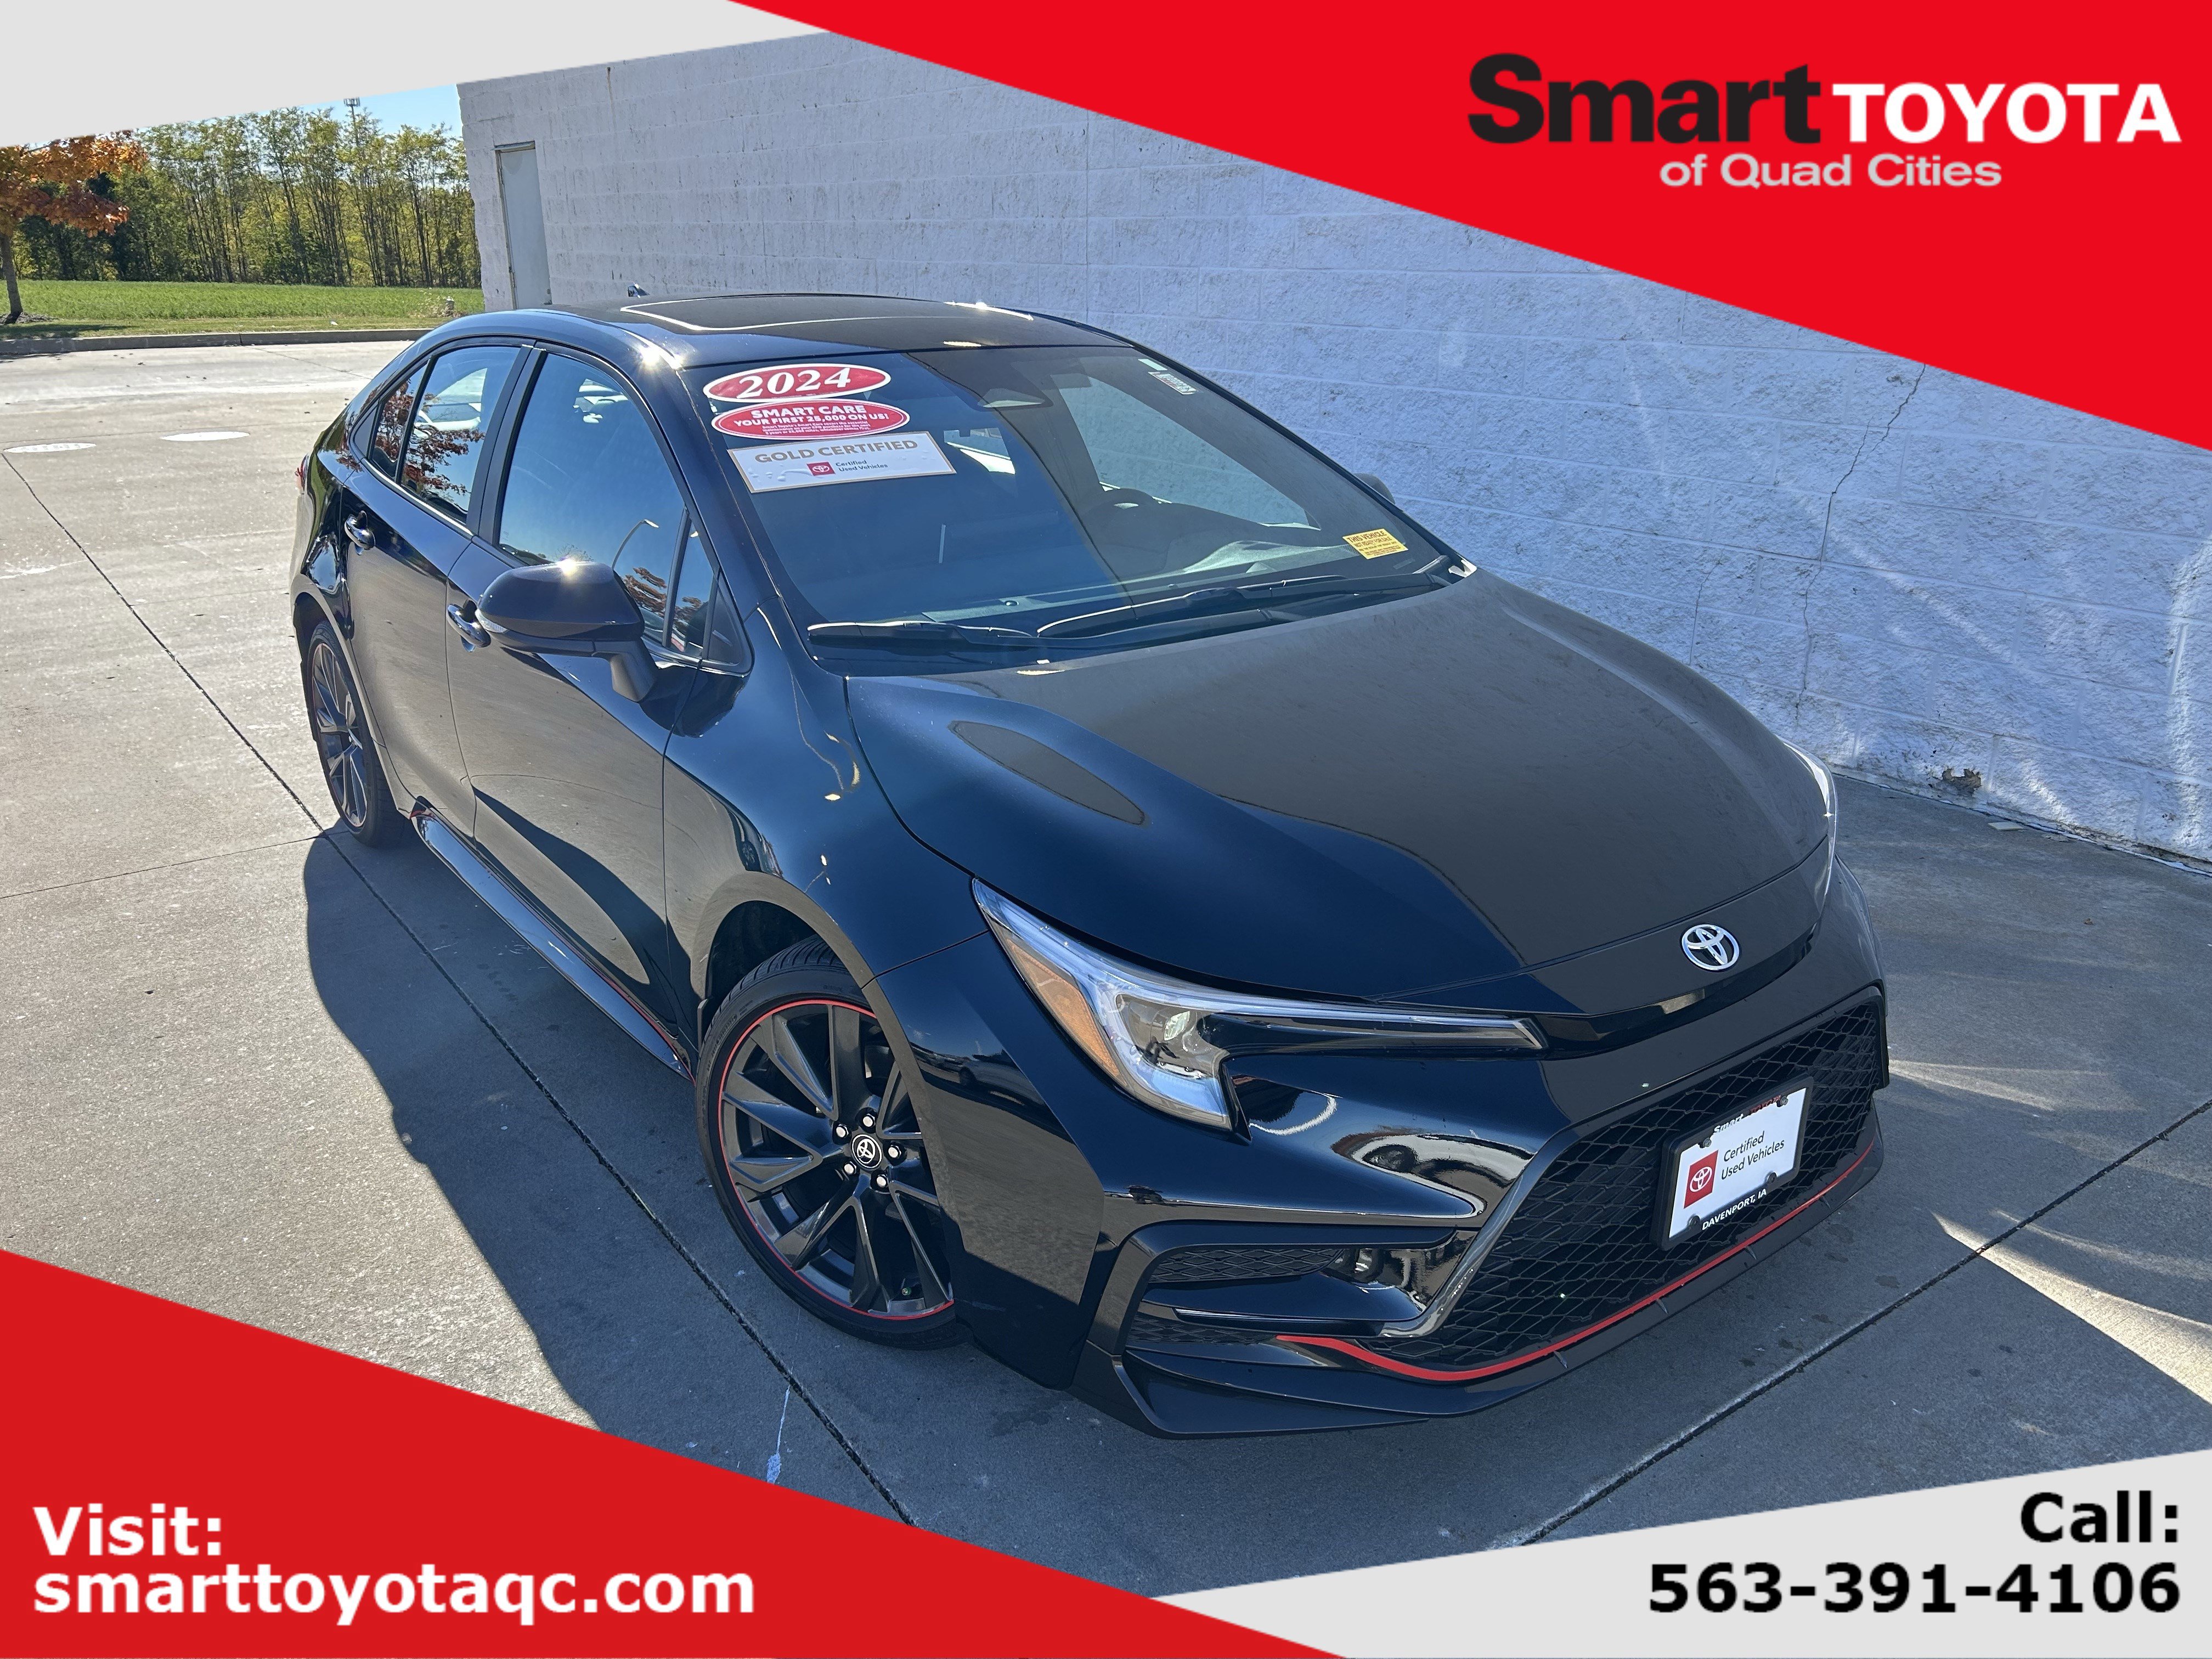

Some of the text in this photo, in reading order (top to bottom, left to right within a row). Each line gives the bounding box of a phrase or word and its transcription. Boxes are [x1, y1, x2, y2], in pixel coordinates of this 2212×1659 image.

[736, 368, 851, 399] 2024
[734, 419, 770, 427] YOUR
[806, 414, 847, 422] 25,000
[751, 405, 867, 419] SMART CARE
[754, 440, 918, 463] GOLD CERTIFIED
[1347, 531, 1387, 543] THIS VEHICLE
[1713, 1113, 1745, 1134] Smart
[1723, 1130, 1765, 1163] Certified
[1720, 1139, 1785, 1180] Used Vehicles
[1702, 1188, 1767, 1231] DAVENPORT, IA
